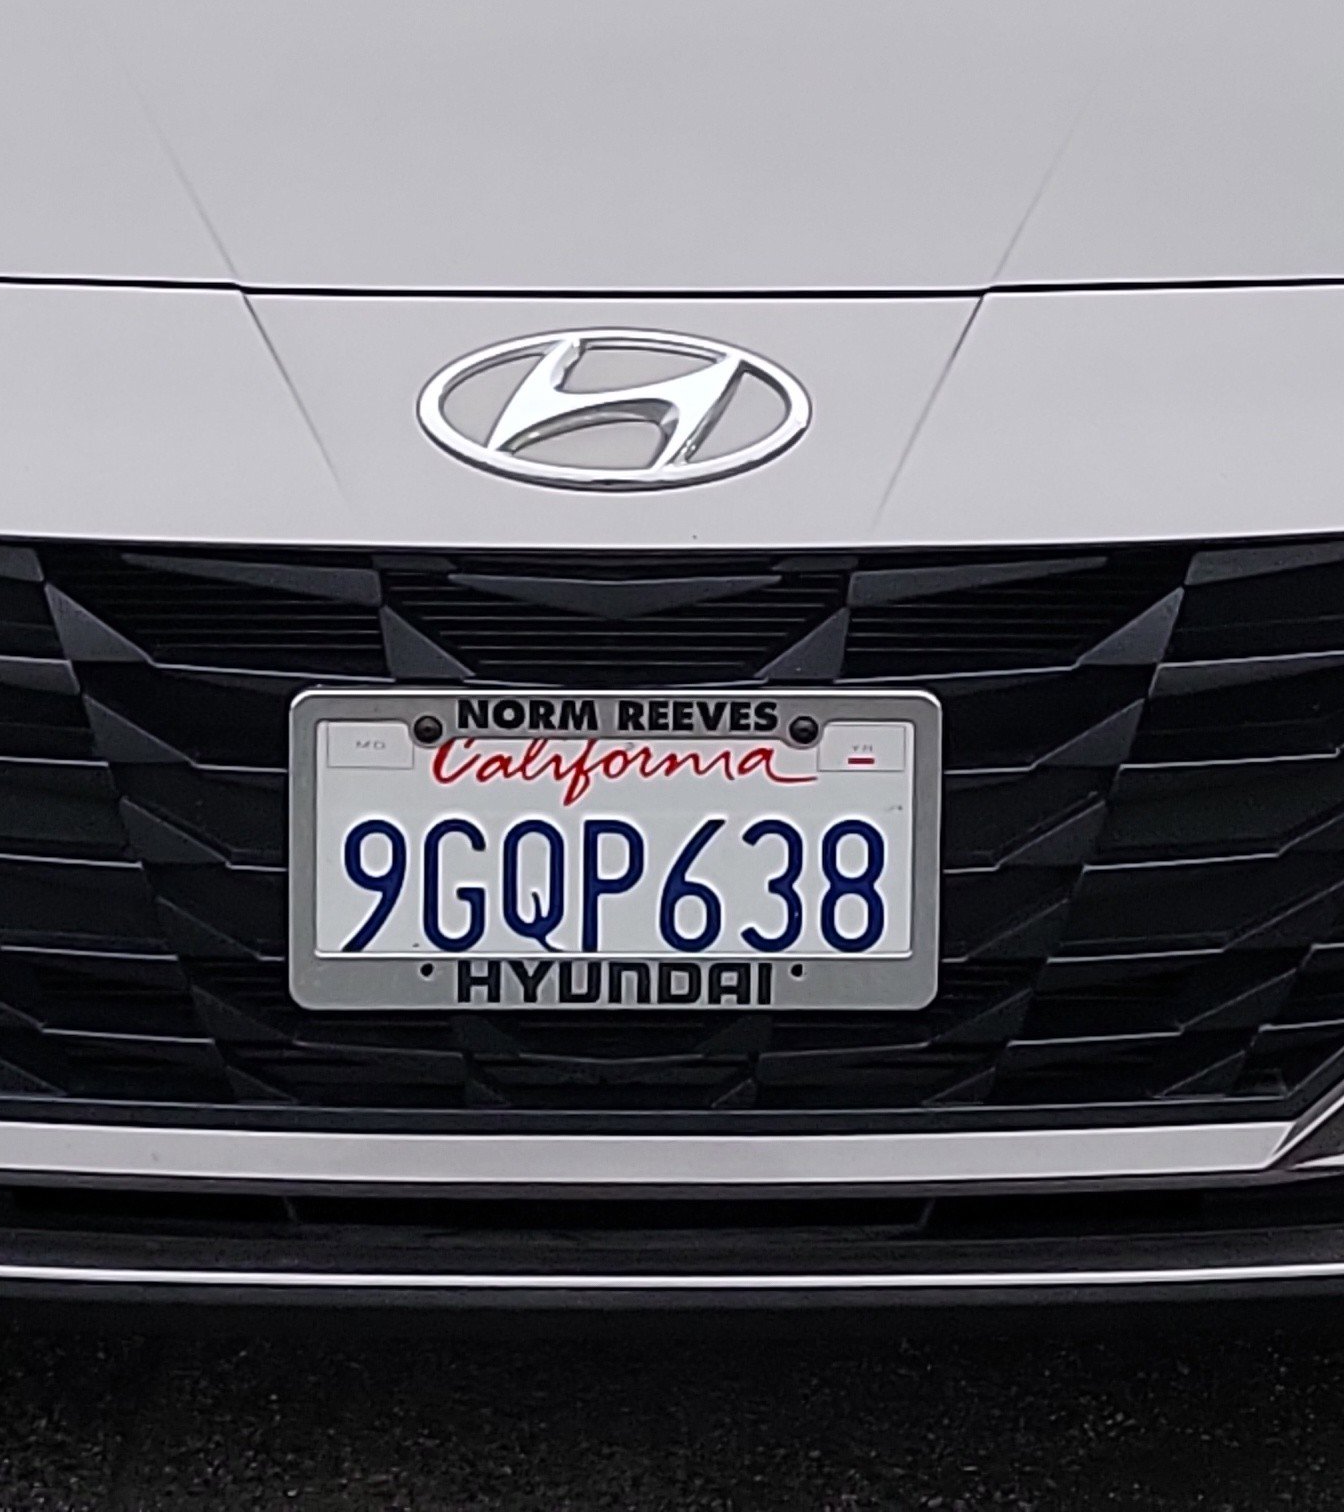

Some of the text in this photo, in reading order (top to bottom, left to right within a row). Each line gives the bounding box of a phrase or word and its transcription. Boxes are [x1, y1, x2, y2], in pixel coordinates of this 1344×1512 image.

[457, 698, 779, 732] NORM REEVES
[429, 737, 819, 806] California
[341, 818, 886, 952] 9GQP638
[457, 961, 774, 1006] HYUNDAI
